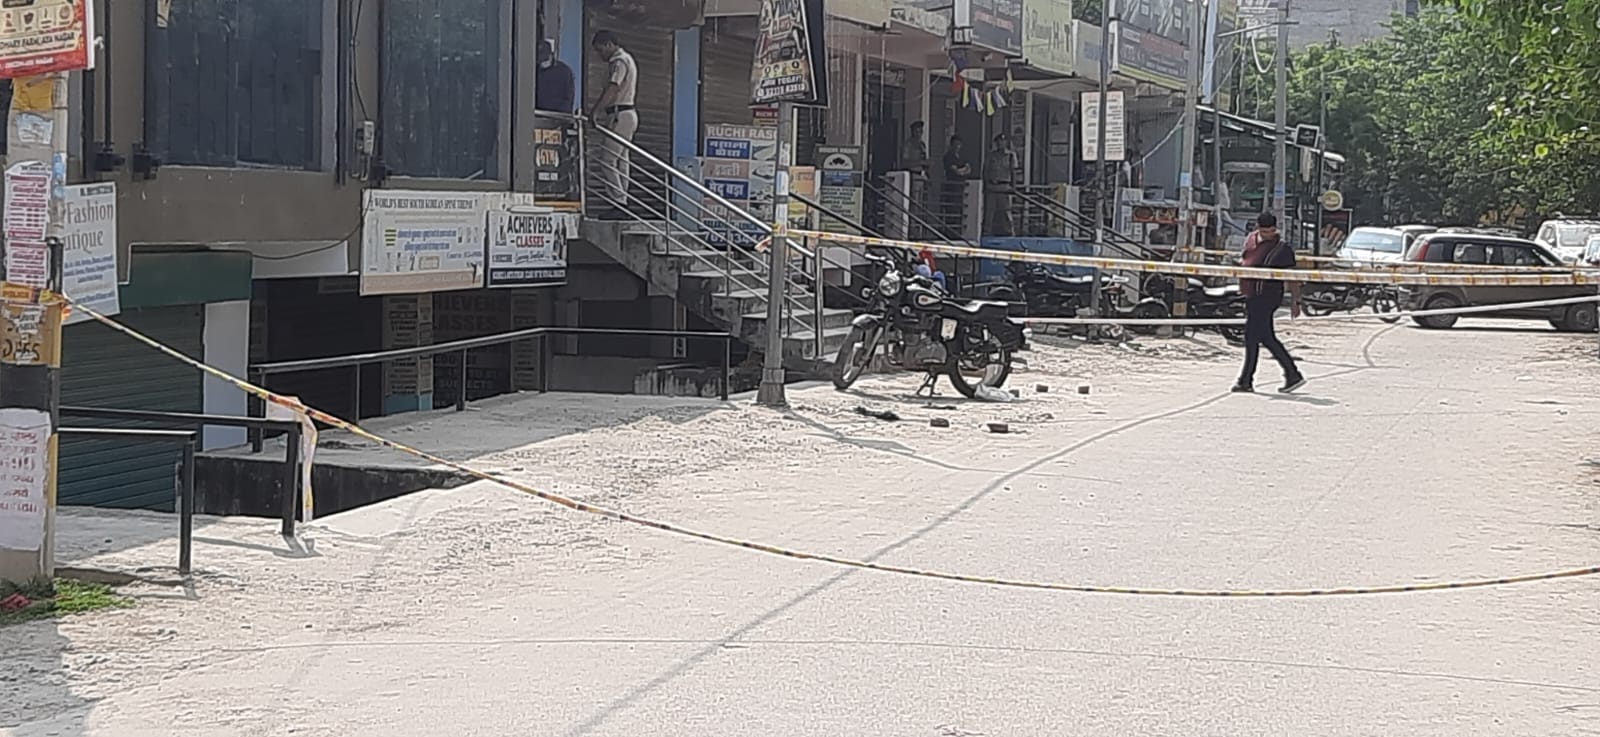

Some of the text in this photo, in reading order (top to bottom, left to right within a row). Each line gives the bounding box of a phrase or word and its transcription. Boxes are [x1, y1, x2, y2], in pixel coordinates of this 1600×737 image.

[707, 126, 745, 137] RUCHI
[397, 198, 409, 209] BEST
[67, 200, 114, 224] Fashion
[507, 215, 552, 234] ACHIEVERS
[516, 235, 544, 248] CLASSES
